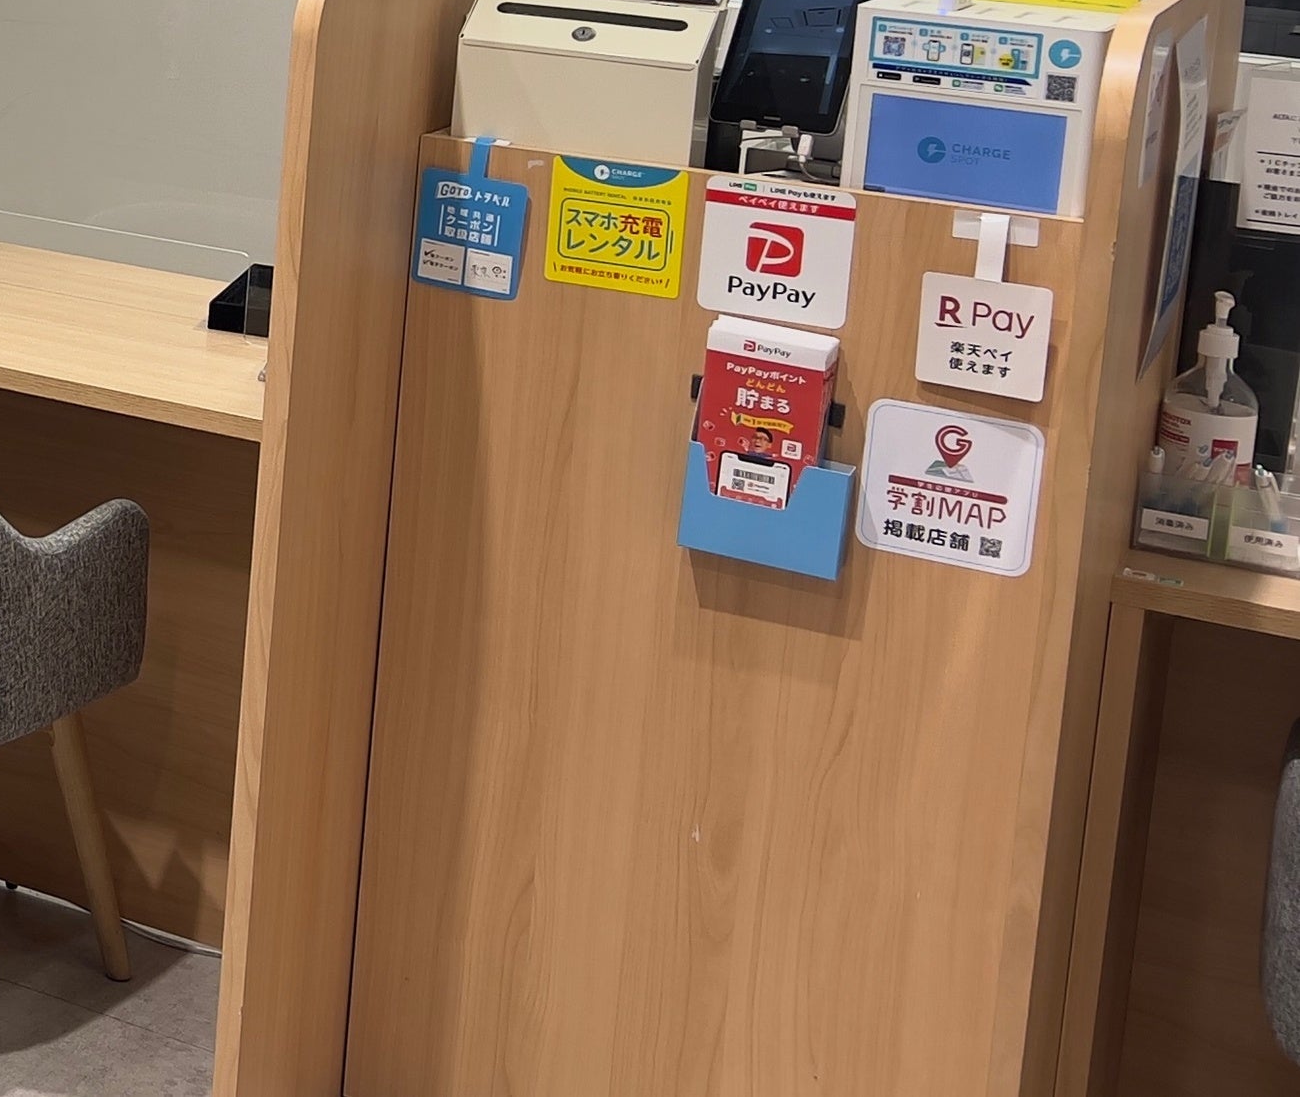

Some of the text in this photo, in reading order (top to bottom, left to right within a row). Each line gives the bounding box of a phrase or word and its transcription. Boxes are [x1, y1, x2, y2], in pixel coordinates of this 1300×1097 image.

[952, 143, 1011, 160] CHARGE
[612, 169, 642, 177] CHARGE
[474, 191, 511, 207] トラベル
[738, 196, 819, 213] ペイペイ使えます
[447, 215, 492, 232] クーポン
[566, 208, 663, 238] スマホ充電
[567, 229, 660, 260] レンタル
[727, 276, 816, 309] PayPay
[934, 295, 1035, 339] R Pay
[757, 345, 791, 358] PayPay
[950, 341, 1013, 363] 楽天ペイ
[726, 362, 806, 385] PayPayポイント
[949, 357, 1011, 378] 使えます
[746, 378, 786, 393] どんどん
[736, 388, 791, 413] 貯まる
[887, 486, 1006, 529] 学割MAP
[883, 519, 970, 551] 掲載店舗
